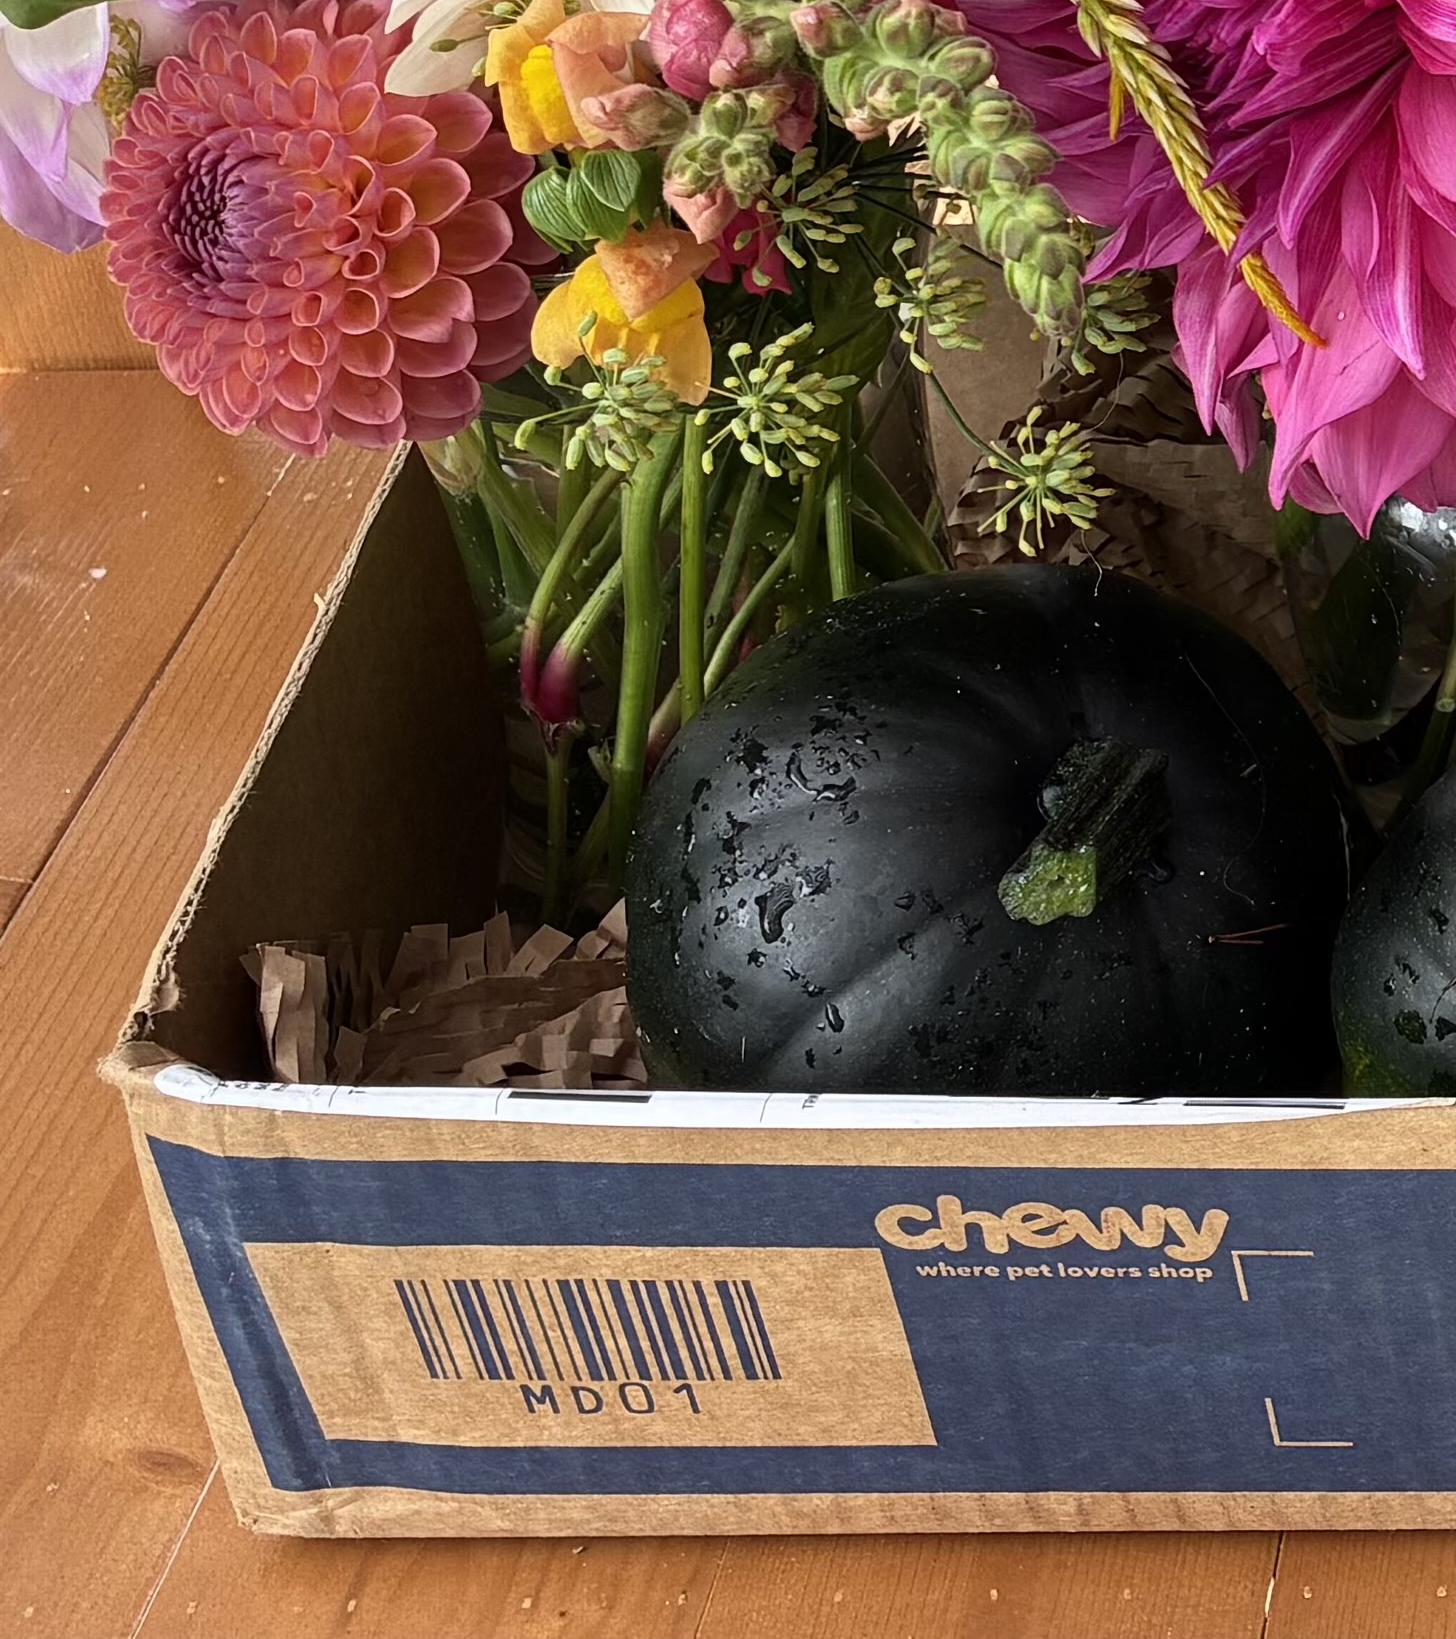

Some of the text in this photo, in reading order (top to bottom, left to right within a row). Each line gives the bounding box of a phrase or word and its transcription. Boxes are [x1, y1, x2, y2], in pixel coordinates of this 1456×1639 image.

[874, 1195, 1230, 1262] chewy
[915, 1262, 1214, 1283] where pet lovers shop
